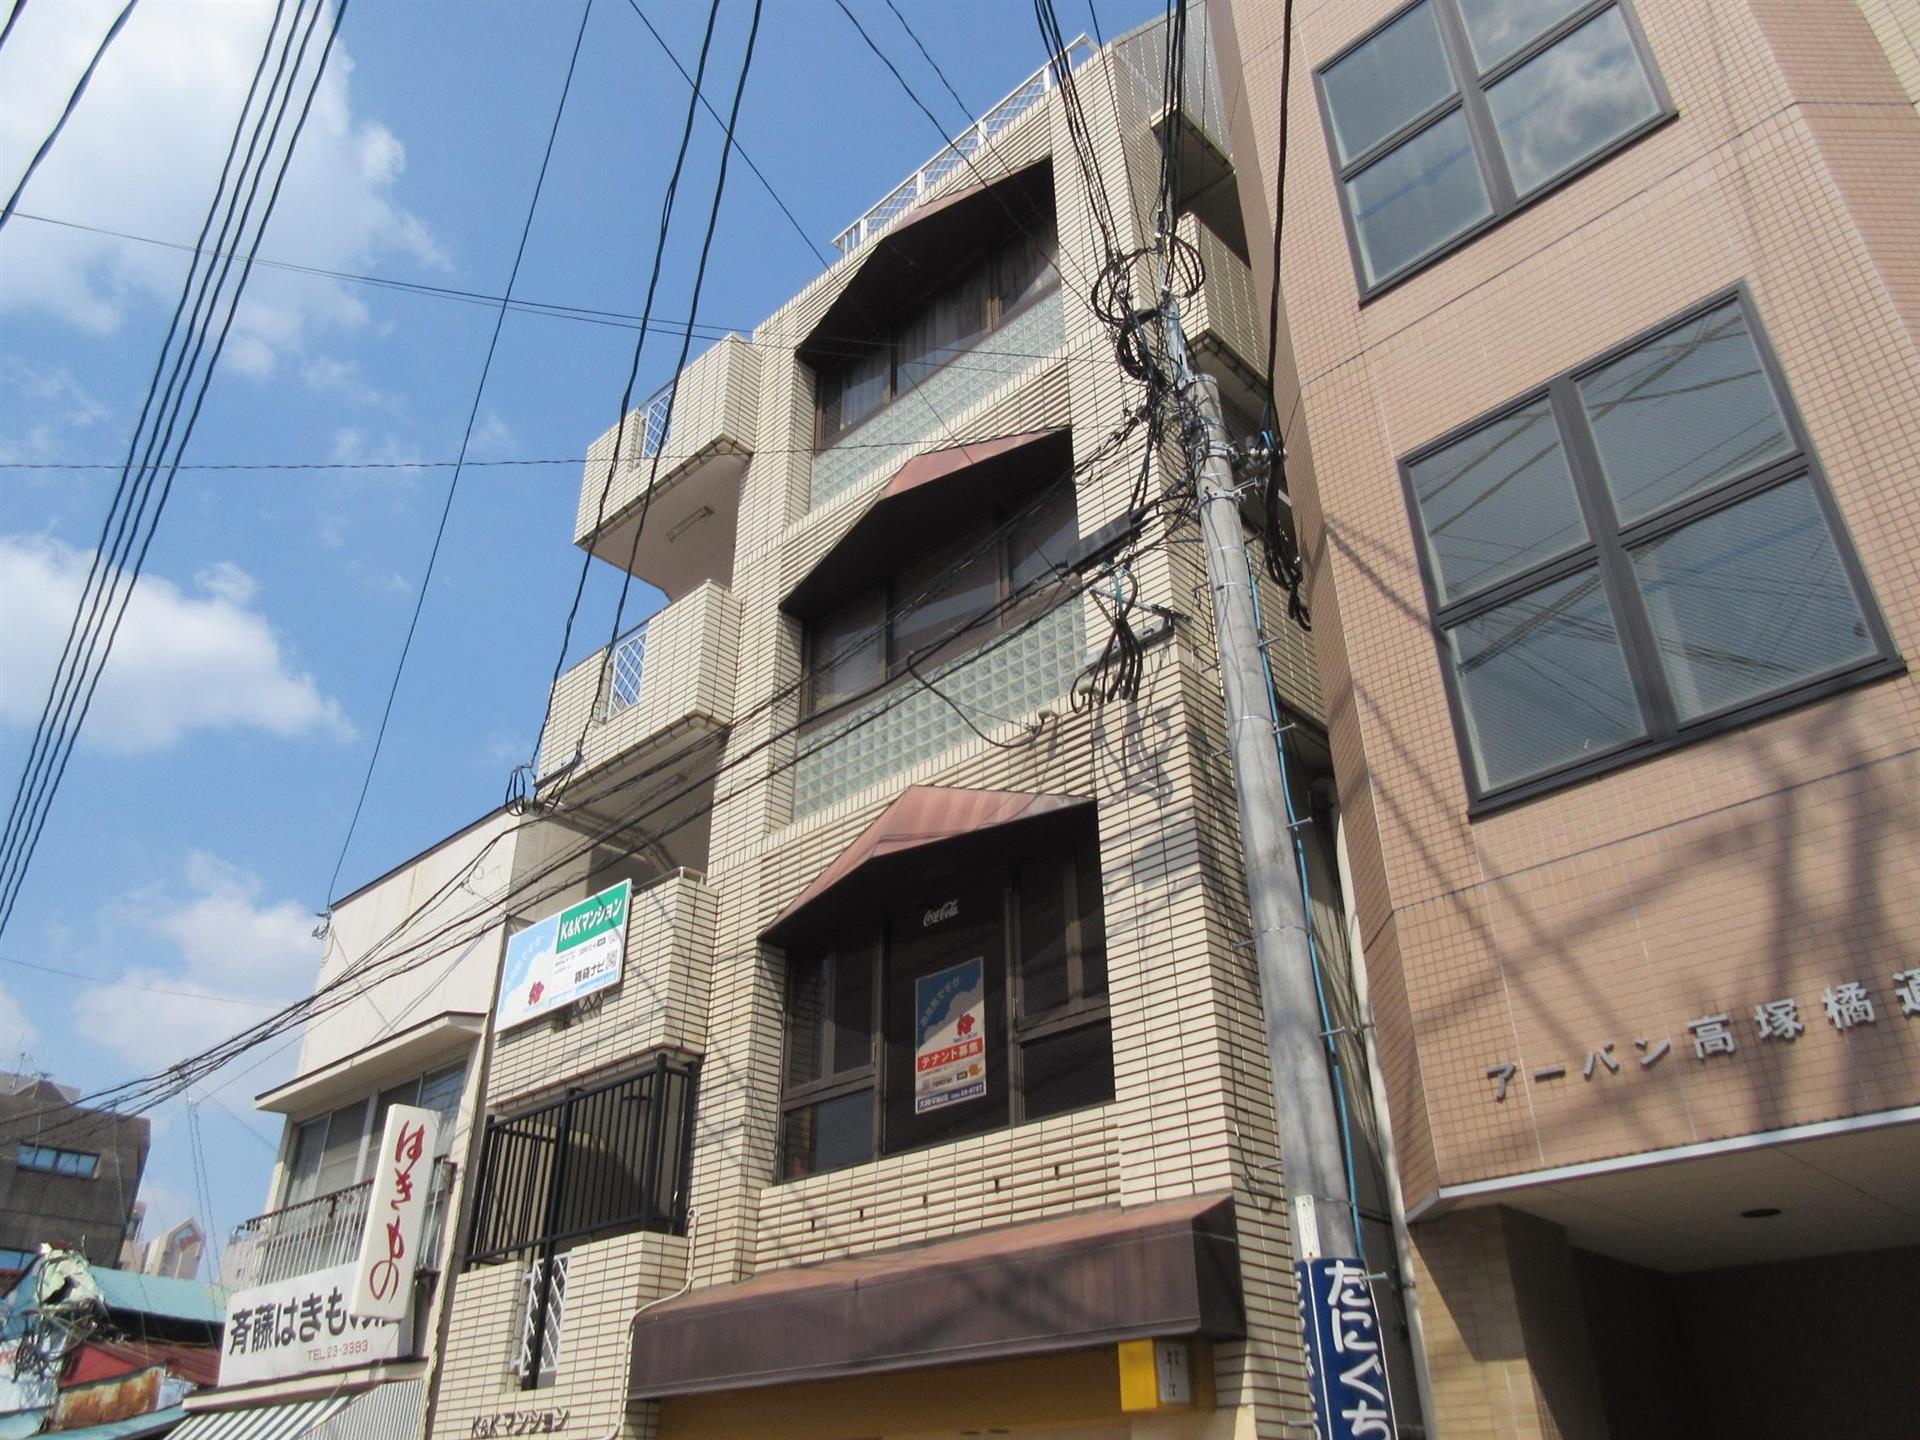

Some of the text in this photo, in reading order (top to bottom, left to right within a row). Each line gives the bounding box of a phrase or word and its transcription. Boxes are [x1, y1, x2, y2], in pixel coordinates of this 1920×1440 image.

[560, 898, 623, 942] K&Kマンション
[229, 1286, 398, 1356] 斉藤はきも
[471, 1407, 571, 1439] K&Kマンション
